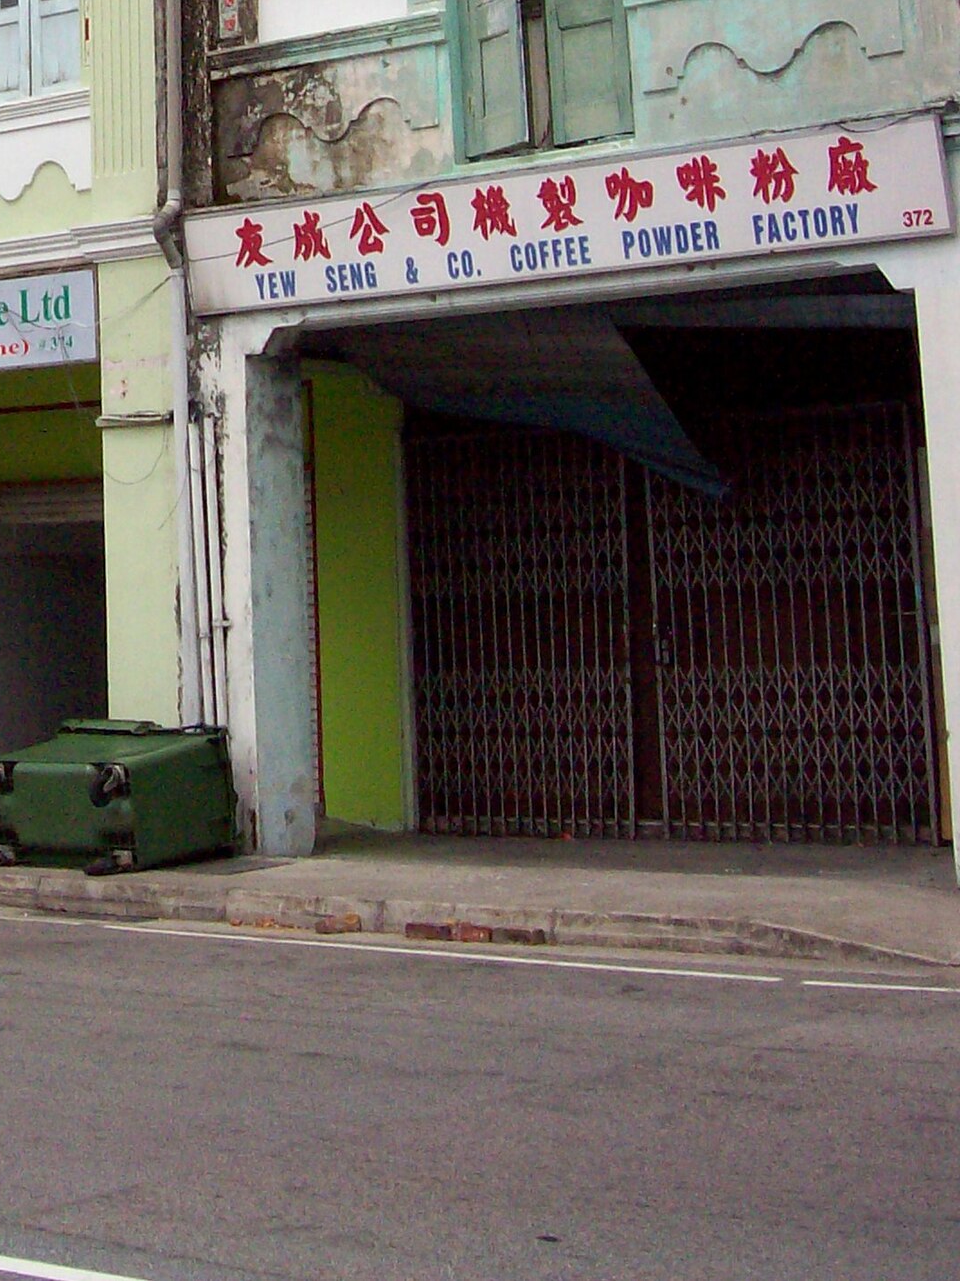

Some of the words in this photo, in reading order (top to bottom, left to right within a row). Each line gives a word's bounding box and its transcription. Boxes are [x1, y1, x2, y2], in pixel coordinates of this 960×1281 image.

[235, 136, 878, 268] 友成公司機製咖啡粉廠
[902, 209, 934, 227] 372
[255, 270, 296, 300] YEW
[325, 261, 378, 293] SENG
[406, 256, 419, 284] &
[447, 249, 482, 280] CO.
[510, 235, 592, 273] COFFEE
[622, 220, 720, 259] POWDER
[752, 203, 859, 245] FACTORY
[19, 285, 71, 323] Ltd
